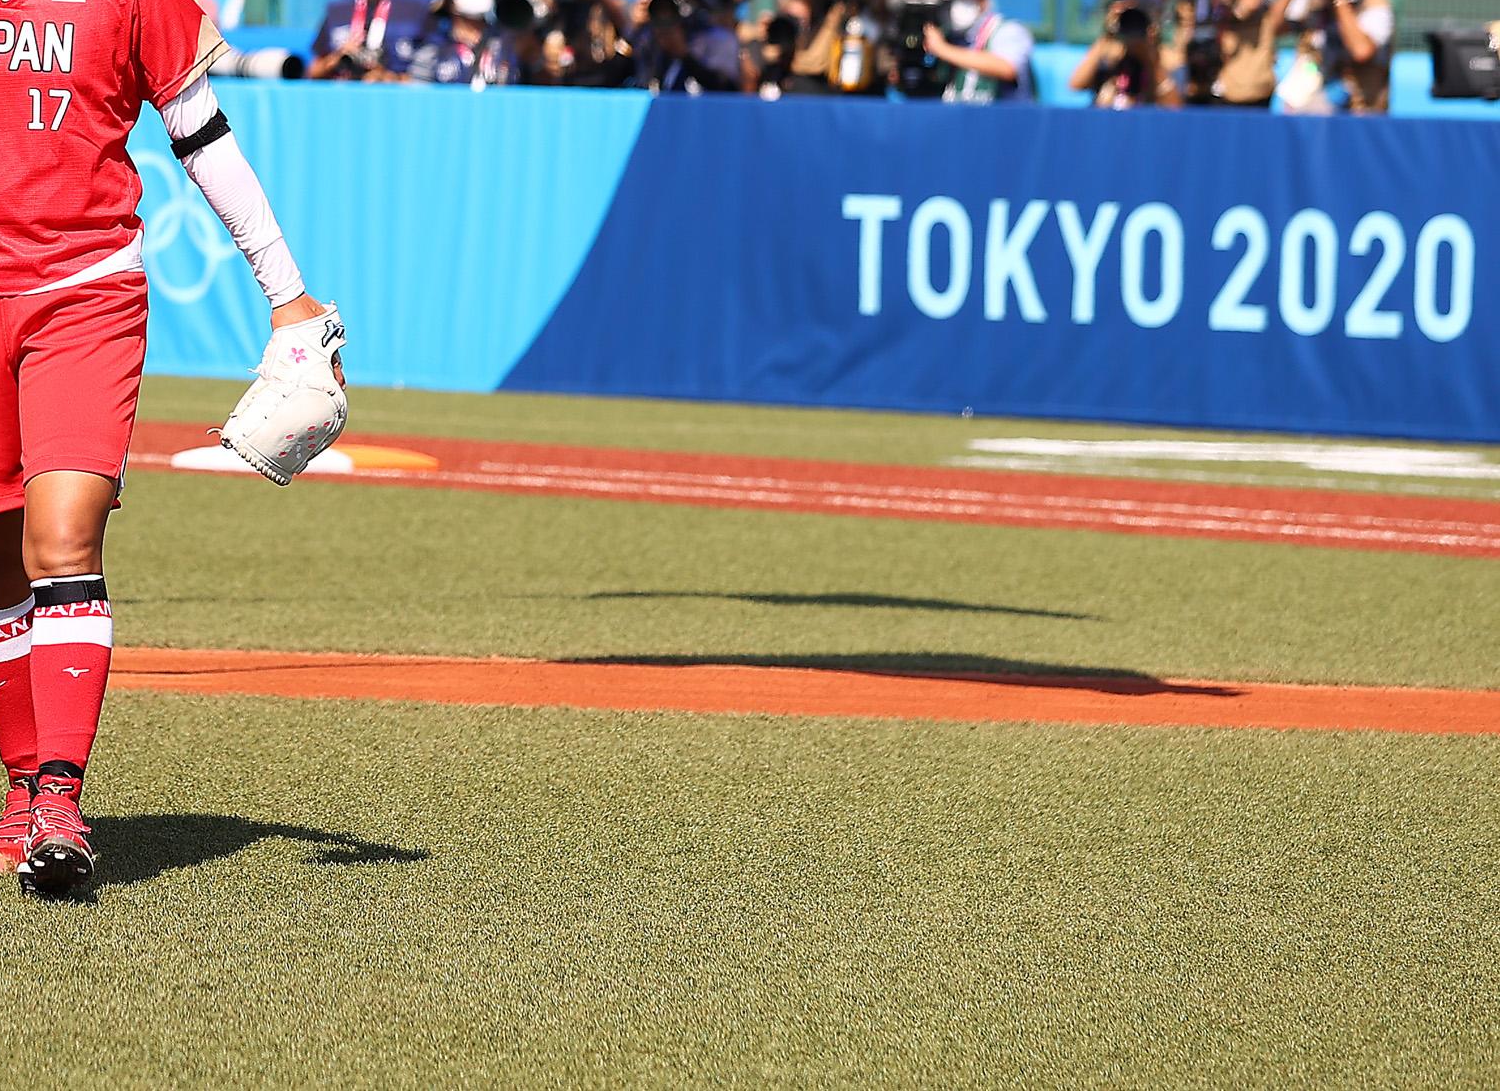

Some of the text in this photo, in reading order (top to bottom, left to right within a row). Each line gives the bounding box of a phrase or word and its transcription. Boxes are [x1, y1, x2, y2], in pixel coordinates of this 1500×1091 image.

[27, 88, 73, 132] 17
[841, 194, 1477, 344] TOKYO 2020
